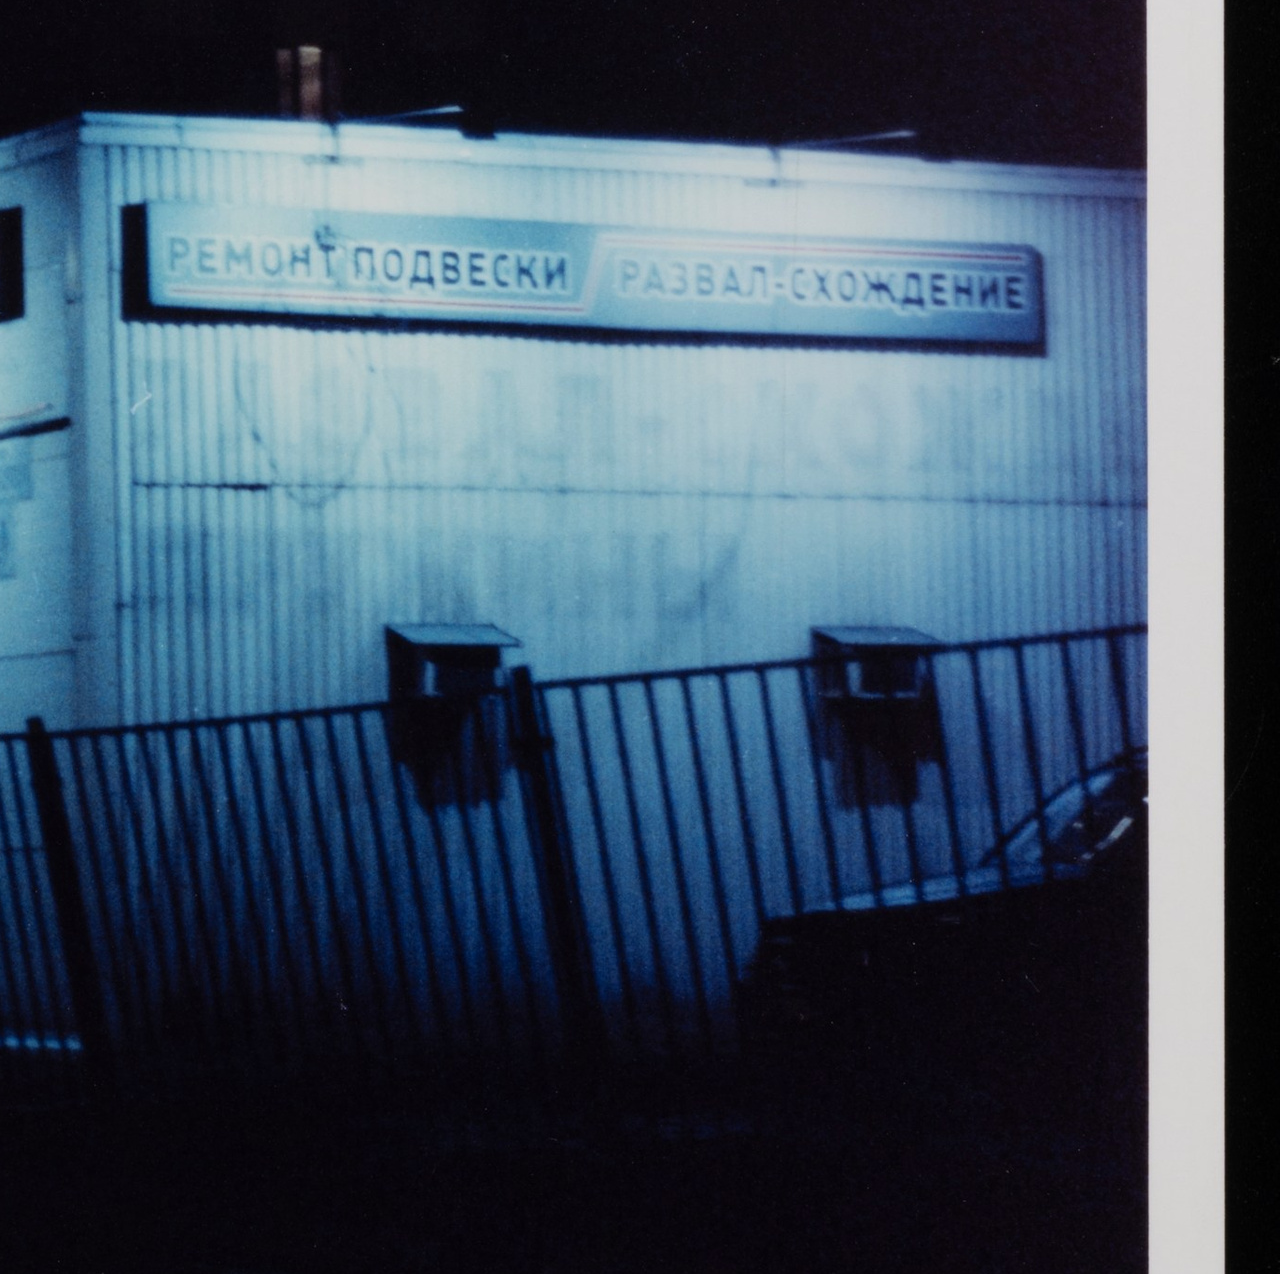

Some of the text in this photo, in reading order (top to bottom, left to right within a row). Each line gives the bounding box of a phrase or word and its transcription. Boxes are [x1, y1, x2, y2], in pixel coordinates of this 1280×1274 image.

[167, 236, 568, 290] РЕМОНТ ПОДВЕСКИ
[621, 259, 1025, 311] РАЗВАЛ-СХОЖДЕНИЕ
